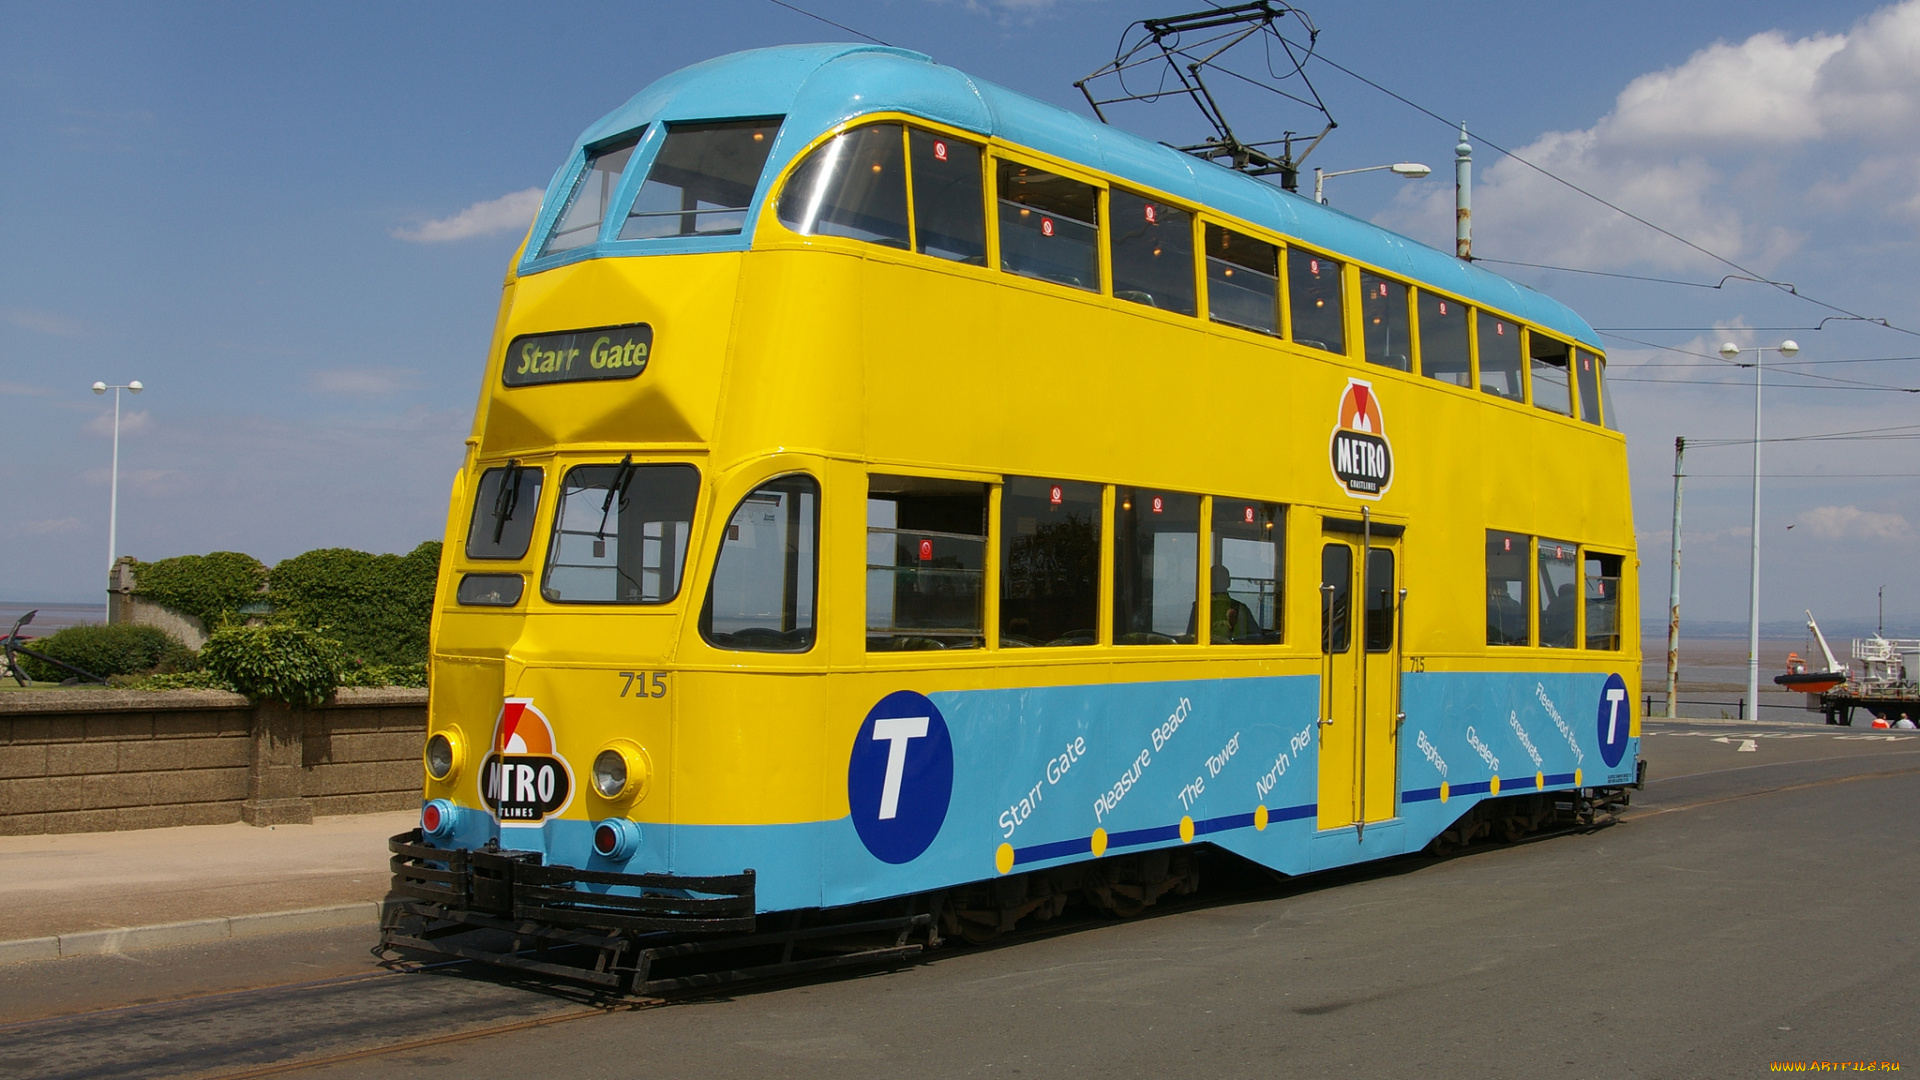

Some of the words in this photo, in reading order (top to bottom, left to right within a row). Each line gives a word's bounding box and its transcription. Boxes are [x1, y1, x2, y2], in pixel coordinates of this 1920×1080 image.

[516, 342, 580, 375] Starr
[589, 336, 647, 369] Gate
[1337, 437, 1386, 479] METRO
[618, 672, 667, 698] 715
[1410, 656, 1425, 673] 715
[1509, 709, 1544, 768] Broadwater
[1535, 681, 1570, 740] Fleetwood
[1567, 730, 1585, 766] Ferry
[1606, 688, 1625, 745] T
[872, 716, 930, 820] T
[1093, 748, 1152, 824] Pleasure
[1150, 696, 1192, 753] Beach
[1177, 776, 1206, 811] The
[1204, 731, 1242, 779] Tower
[1255, 753, 1291, 801] North
[1290, 722, 1313, 759] Pier
[1416, 729, 1448, 778] Bispham
[1465, 725, 1500, 772] Cleveleys
[487, 761, 555, 803] MTRO
[997, 780, 1043, 839] Starr
[1046, 735, 1087, 785] Gate
